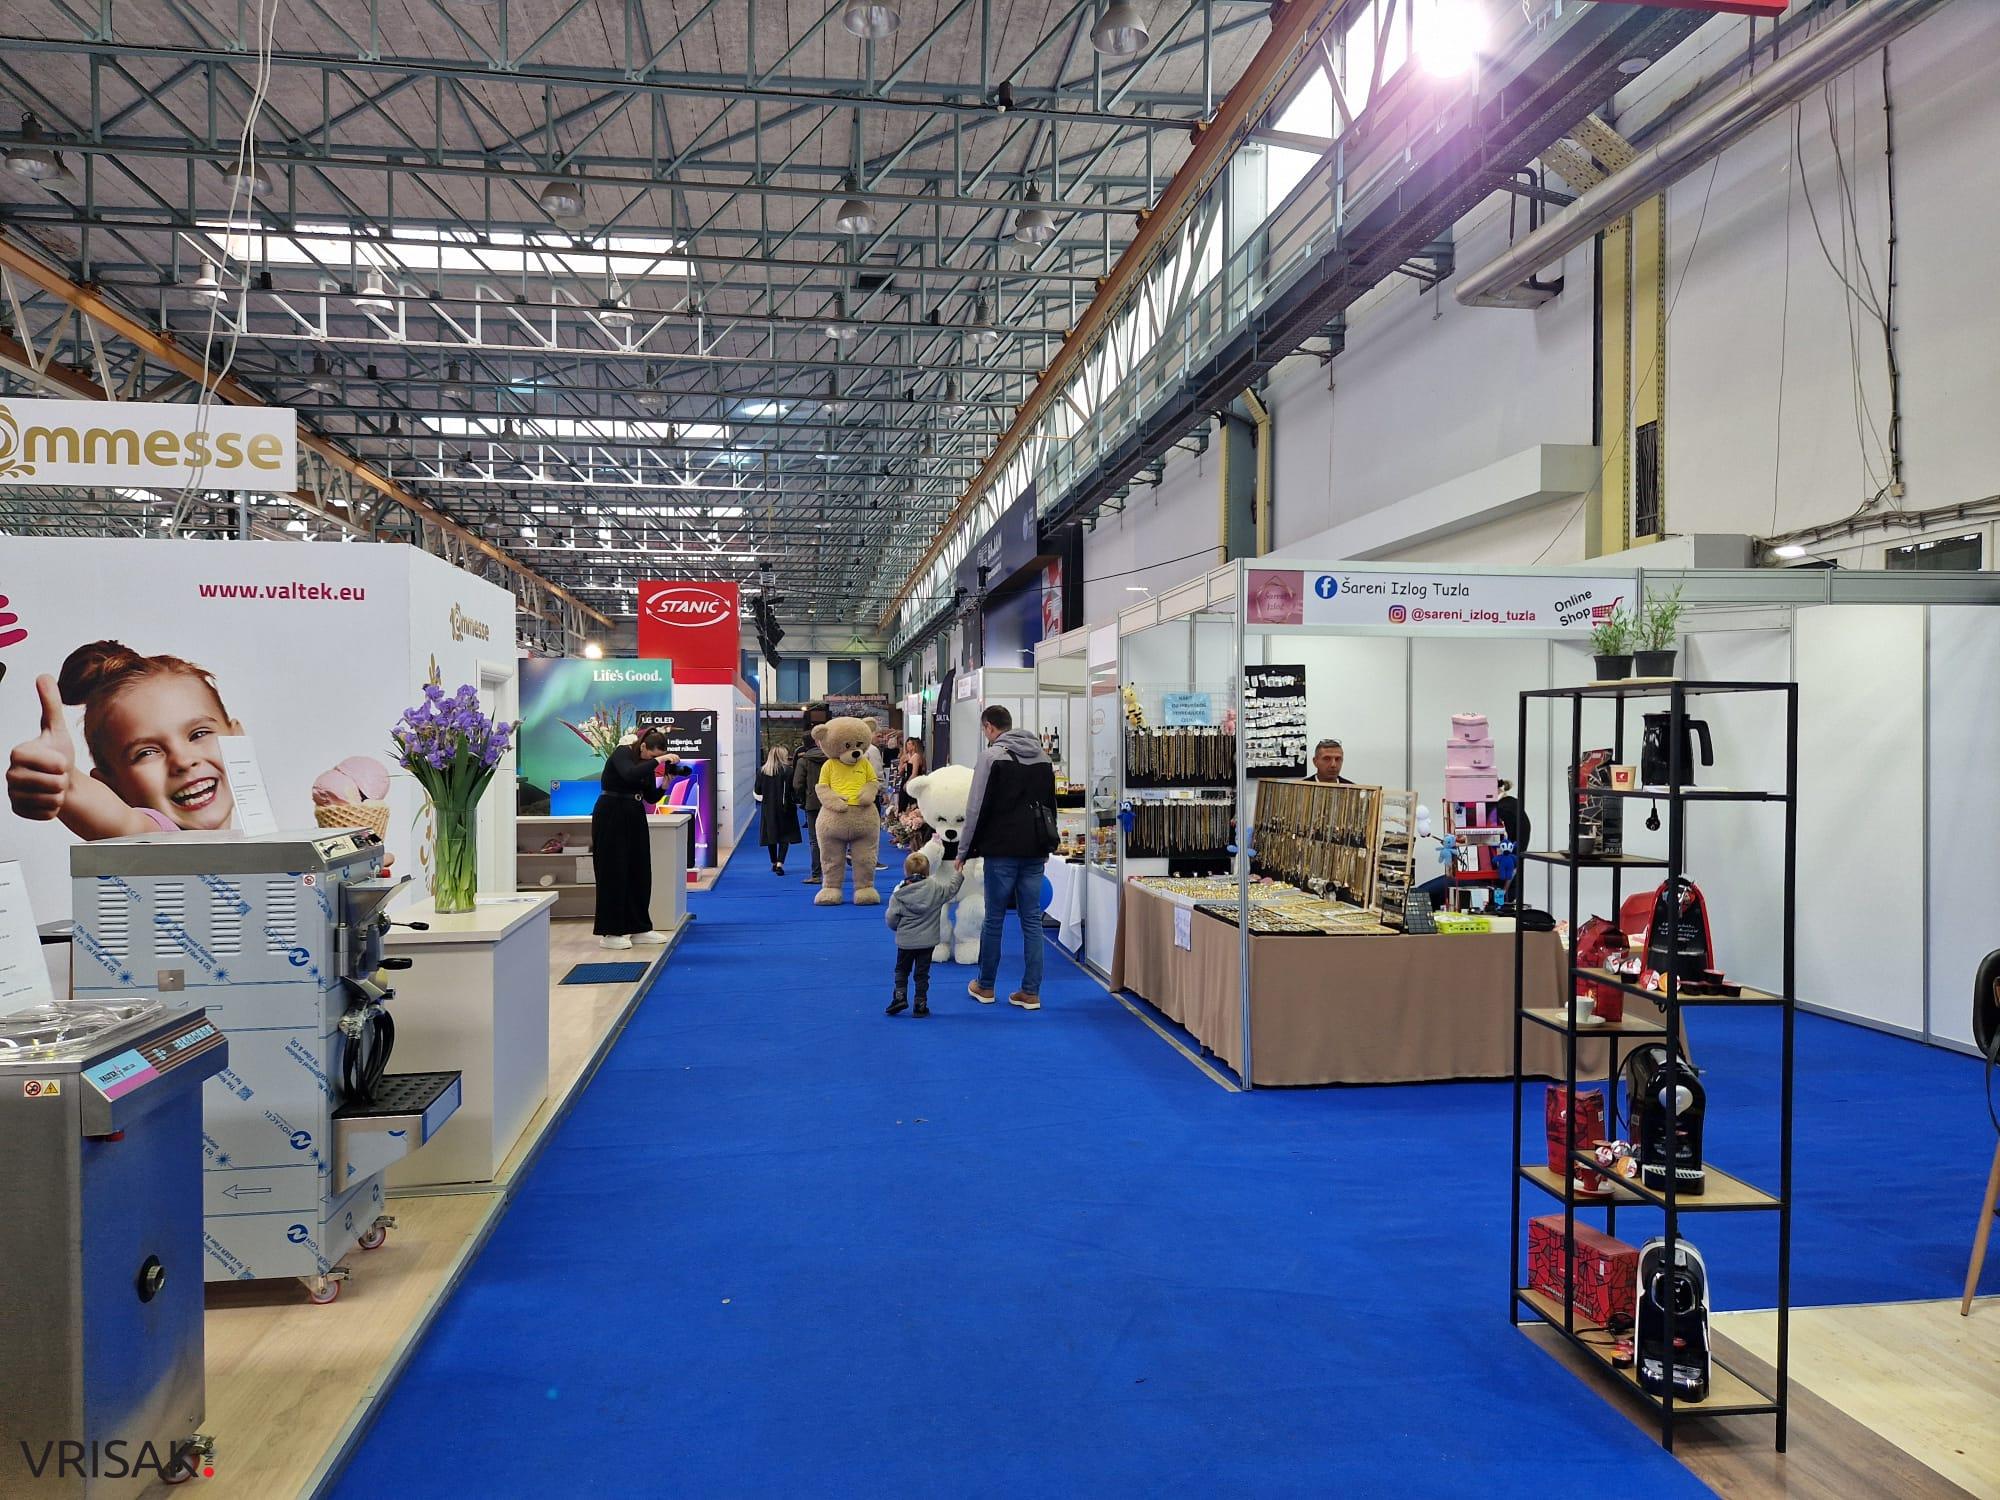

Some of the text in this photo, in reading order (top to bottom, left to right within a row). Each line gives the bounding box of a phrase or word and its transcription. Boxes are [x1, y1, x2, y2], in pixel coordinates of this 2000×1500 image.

[199, 582, 365, 600] www.valtek.eu
[1340, 577, 1469, 599] Šareni Izlog Tuzla
[657, 599, 721, 614] STANIĆ
[1553, 589, 1592, 613] Online
[1411, 608, 1536, 623] @sareni_izlog_tuzla
[1559, 607, 1591, 627] Shop
[593, 670, 662, 681] Life's Good.
